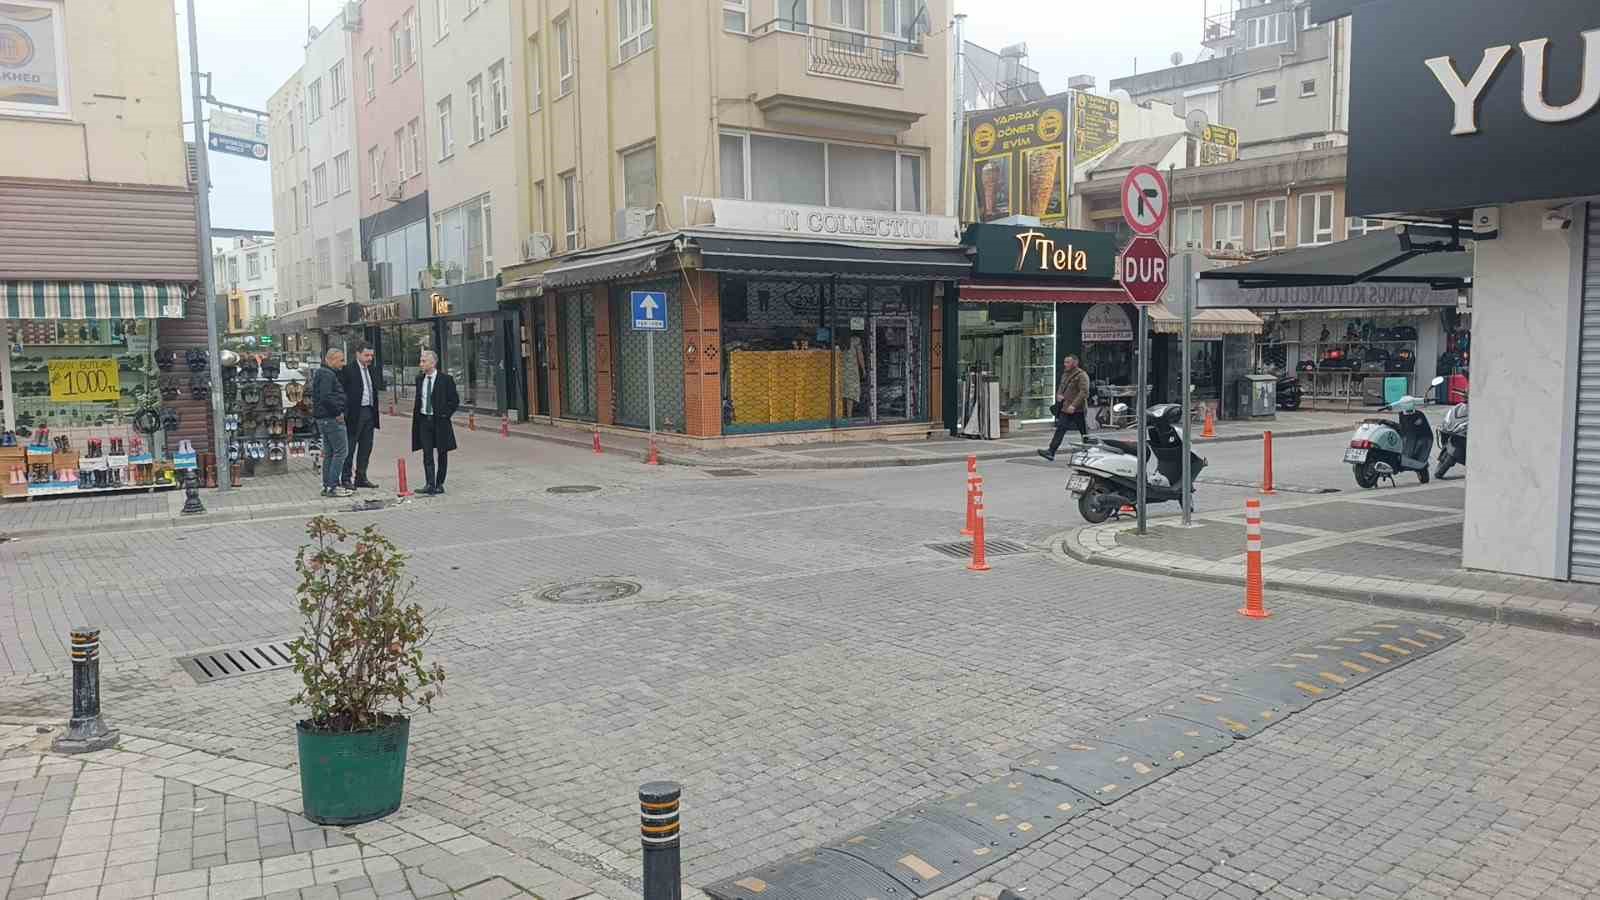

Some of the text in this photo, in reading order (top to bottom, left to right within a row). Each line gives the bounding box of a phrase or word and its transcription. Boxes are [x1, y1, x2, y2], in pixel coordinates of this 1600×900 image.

[1424, 26, 1600, 136] YU
[993, 108, 1040, 124] YAPRAK
[1036, 239, 1088, 272] Tela
[1125, 257, 1165, 283] DUR
